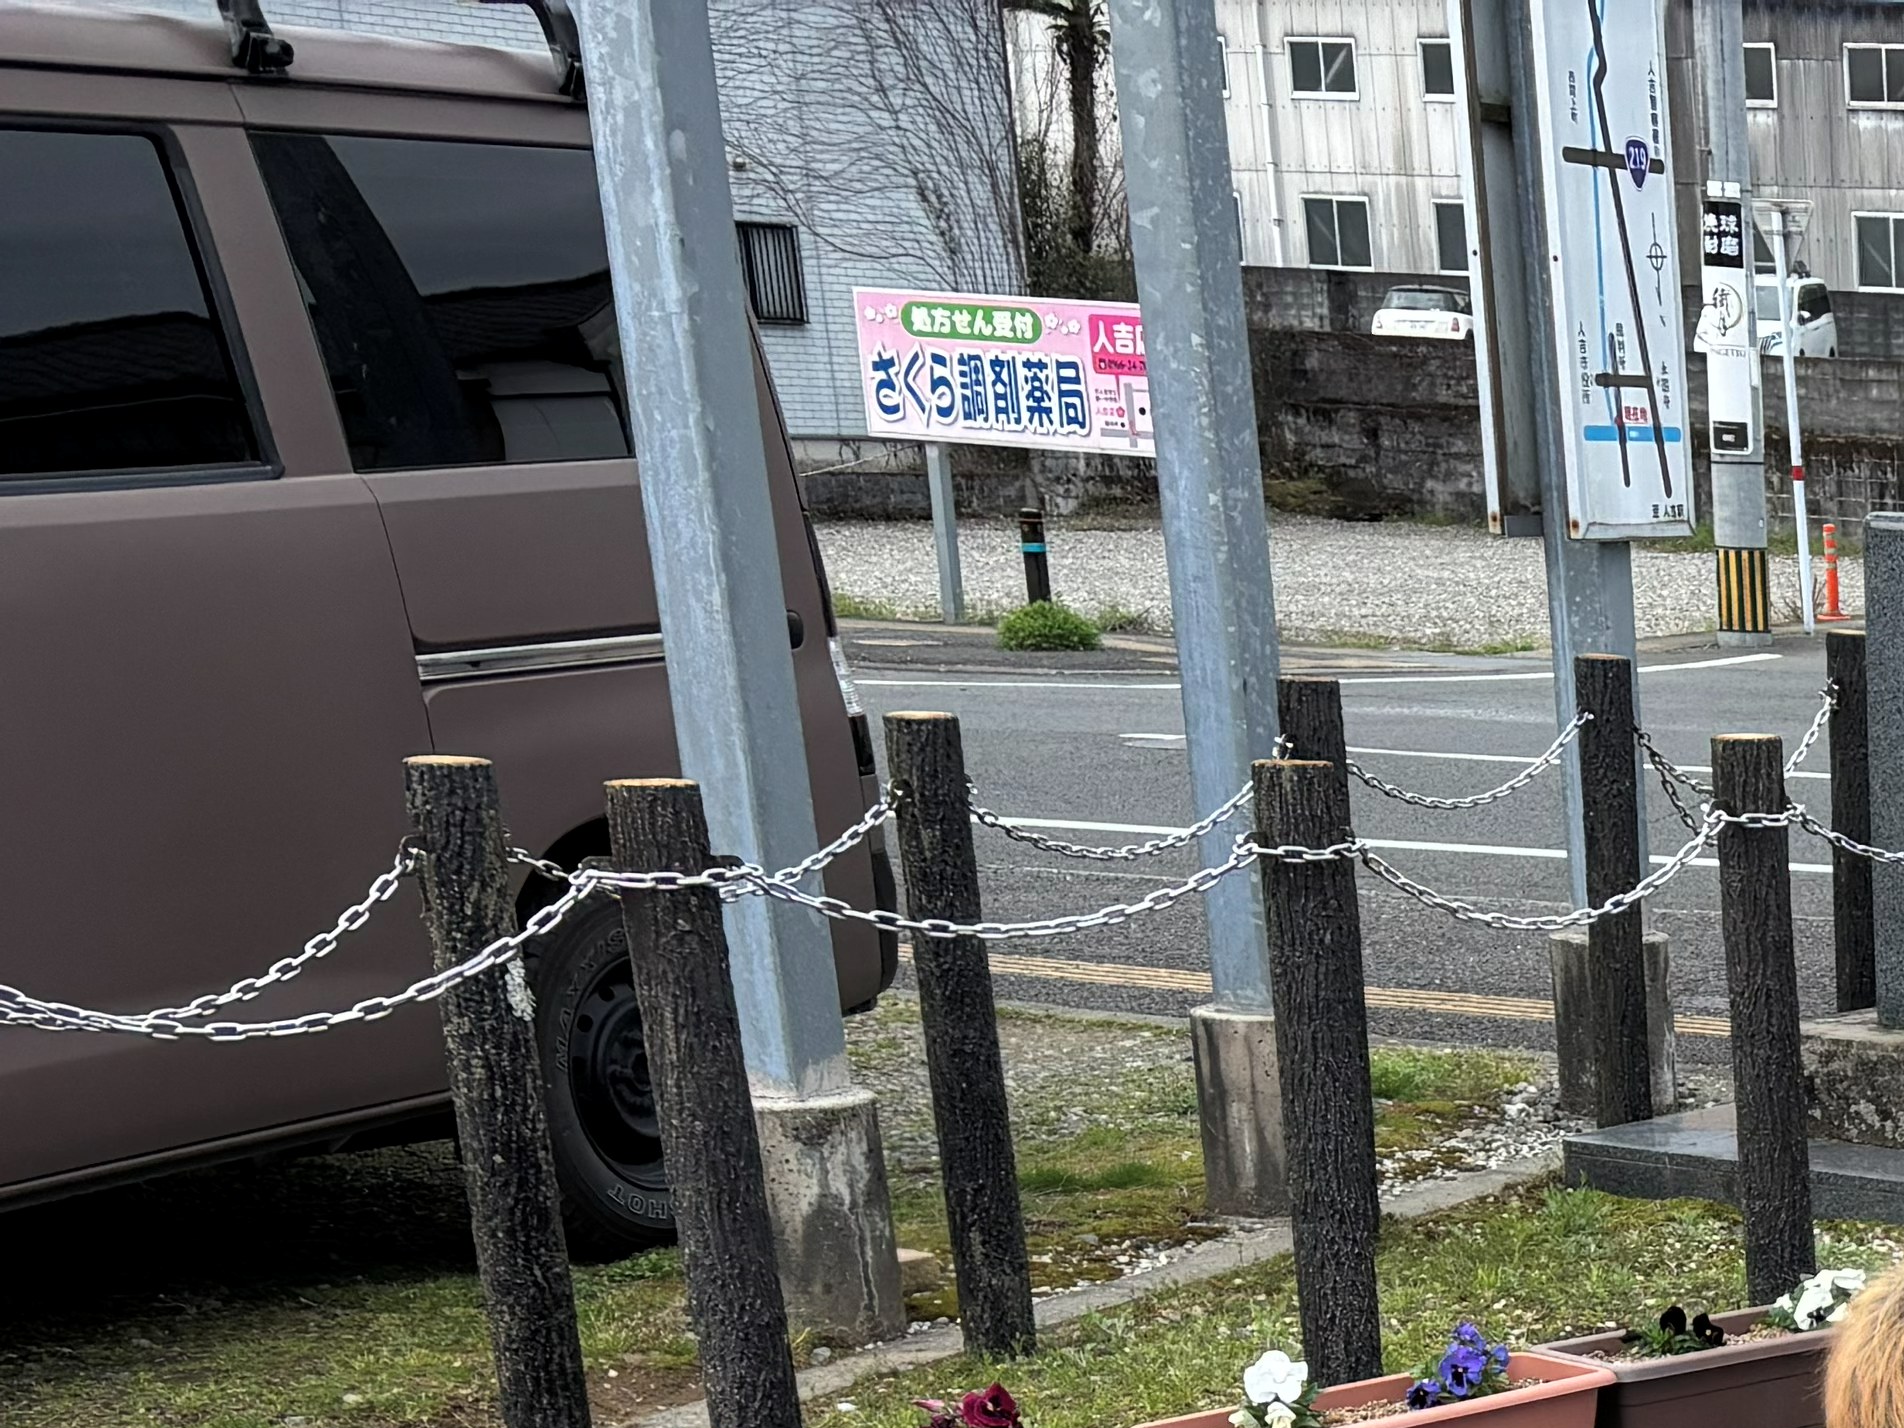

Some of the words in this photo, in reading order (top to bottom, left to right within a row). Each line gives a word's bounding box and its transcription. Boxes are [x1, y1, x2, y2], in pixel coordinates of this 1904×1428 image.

[1629, 146, 1647, 170] 219
[911, 306, 1034, 340] 処方せん受付
[870, 349, 1088, 432] さくら調剤薬局
